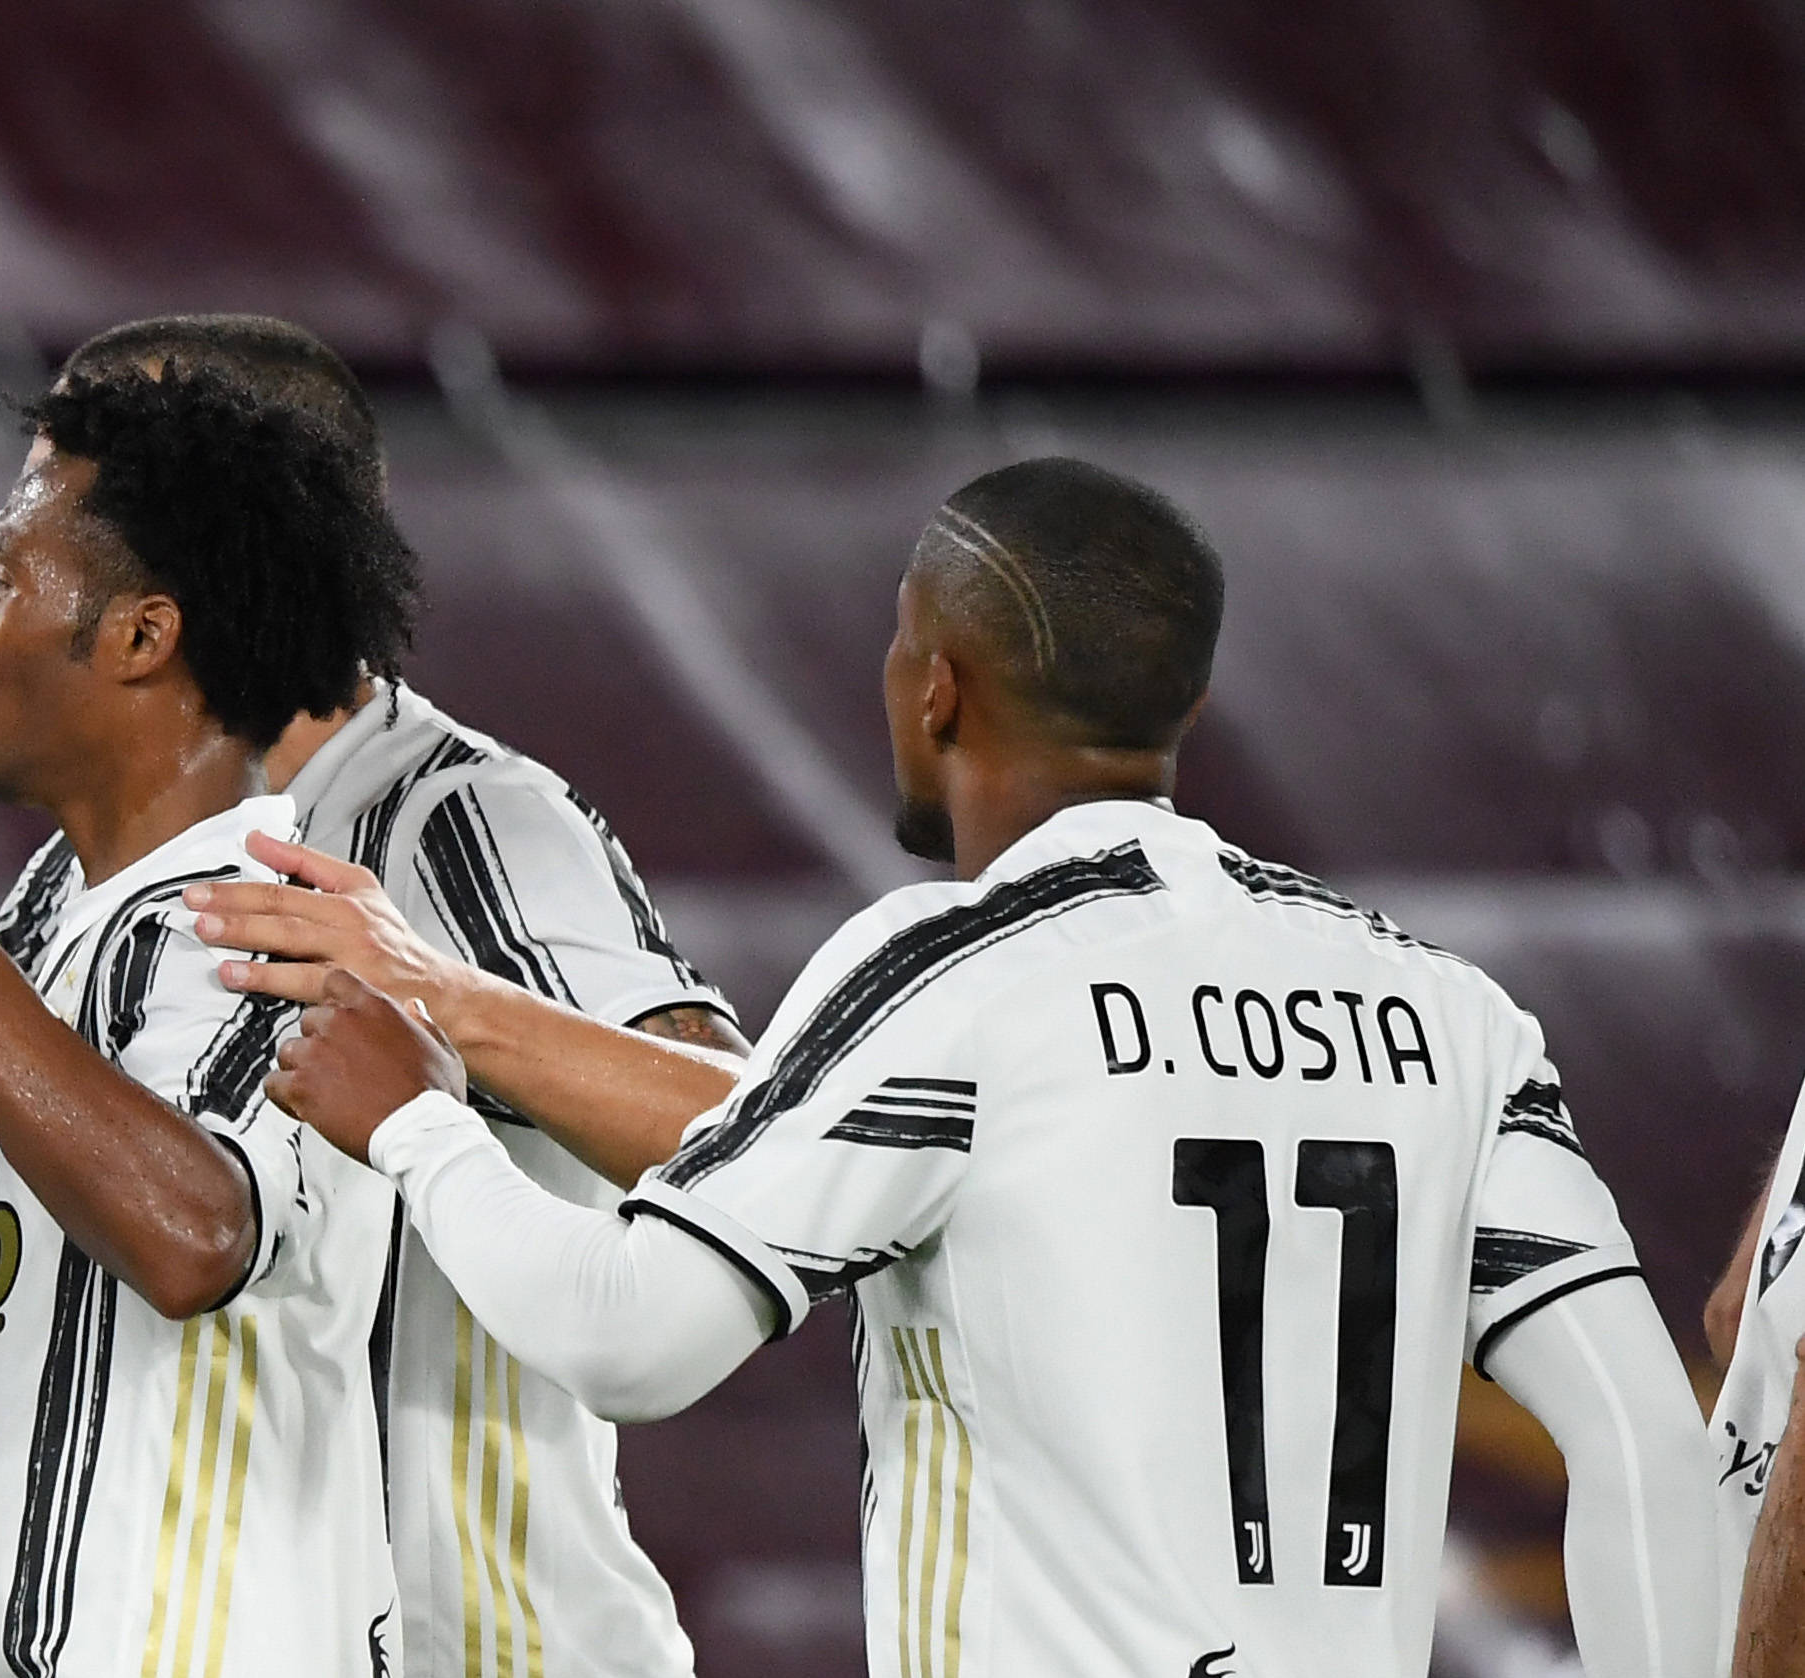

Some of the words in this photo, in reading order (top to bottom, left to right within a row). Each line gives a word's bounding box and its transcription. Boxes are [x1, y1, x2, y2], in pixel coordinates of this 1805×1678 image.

[1089, 981, 1176, 1076] D.
[1192, 984, 1438, 1086] COSTA
[1171, 1136, 1399, 1587] 11
